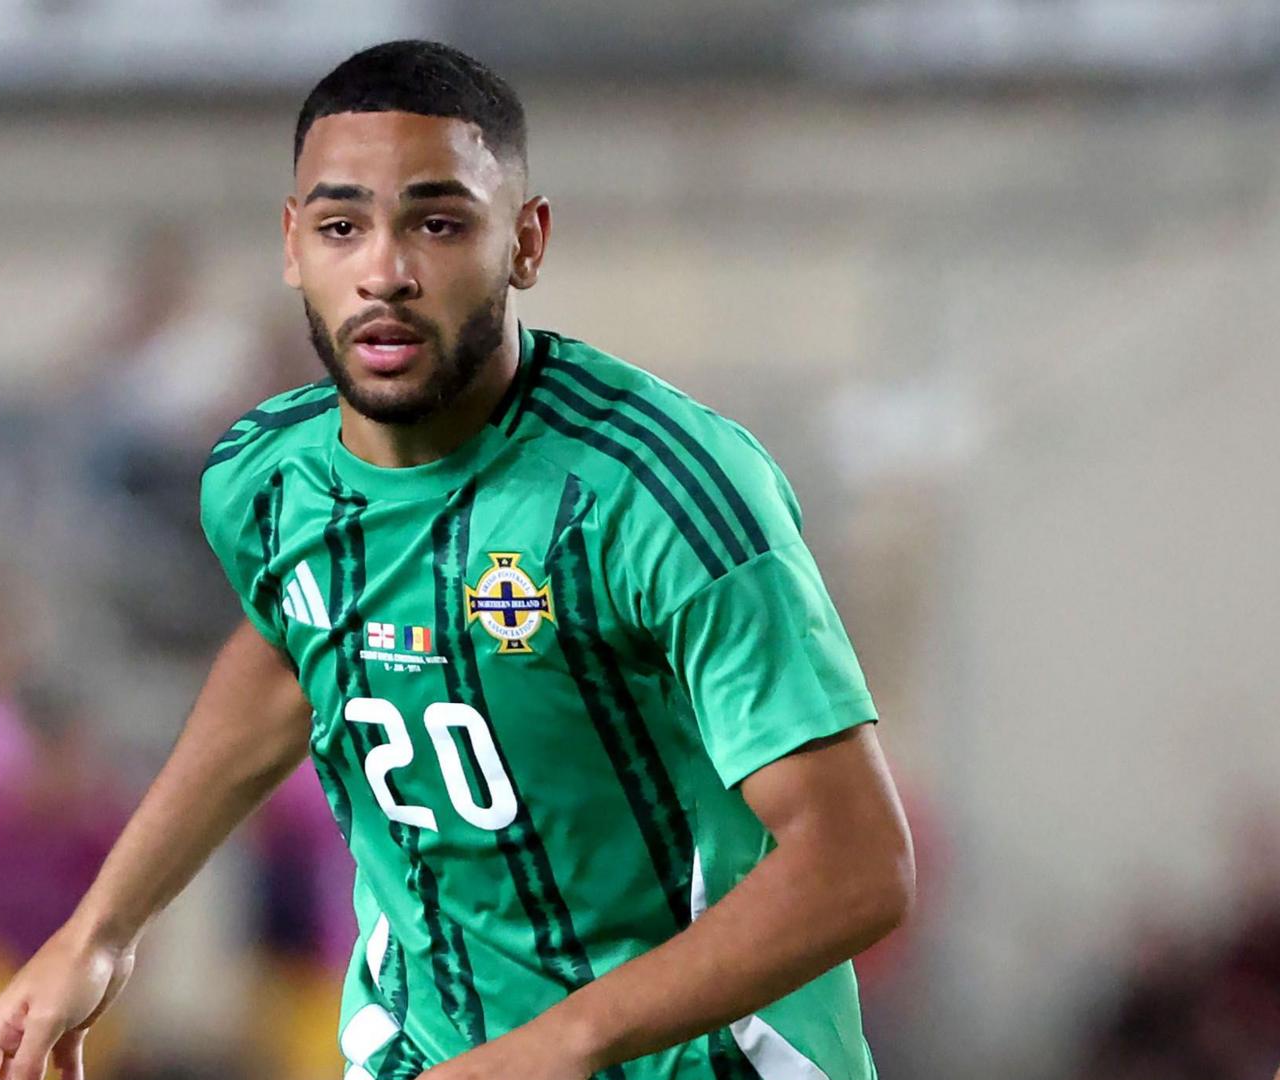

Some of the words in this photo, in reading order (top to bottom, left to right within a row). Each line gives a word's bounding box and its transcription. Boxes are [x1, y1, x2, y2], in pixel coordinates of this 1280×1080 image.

[477, 600, 511, 608] NORTHERN
[511, 600, 540, 608] IRELAND
[344, 697, 518, 833] 20
